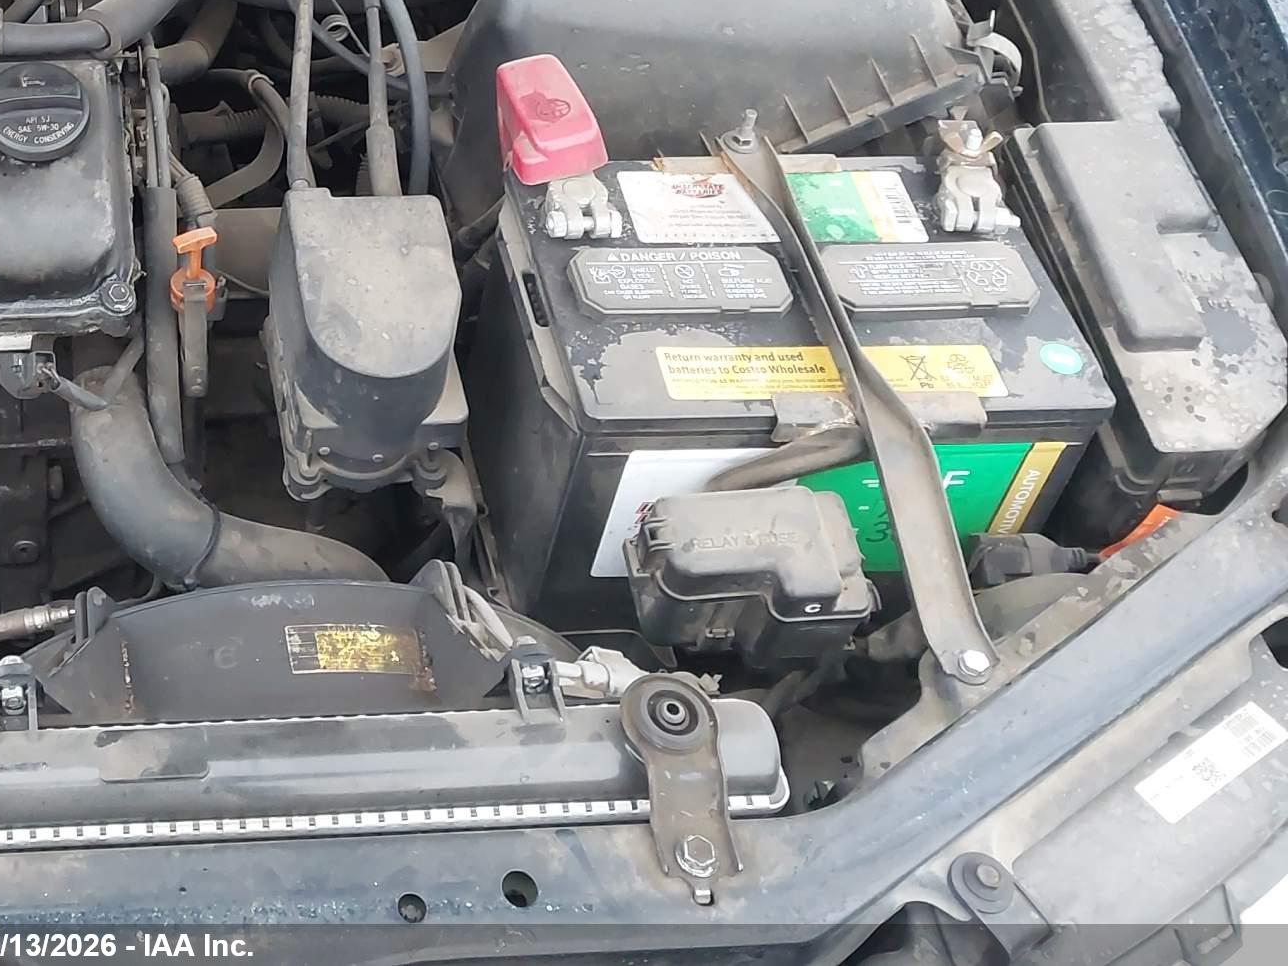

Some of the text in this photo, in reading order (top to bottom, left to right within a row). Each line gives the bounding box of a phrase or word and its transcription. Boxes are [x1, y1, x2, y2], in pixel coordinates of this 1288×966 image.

[25, 115, 51, 124] API SJ
[2, 121, 75, 144] ENERGY CONSERVING
[17, 123, 60, 133] SAE 5W-30
[620, 251, 741, 262] DANGER / POISON
[664, 351, 804, 363] Return warranty and used
[668, 364, 826, 375] batteries to Costco Wholesale
[919, 381, 934, 389] Pb
[997, 469, 1041, 535] AUTOMOTIV
[691, 534, 741, 550] RELAY
